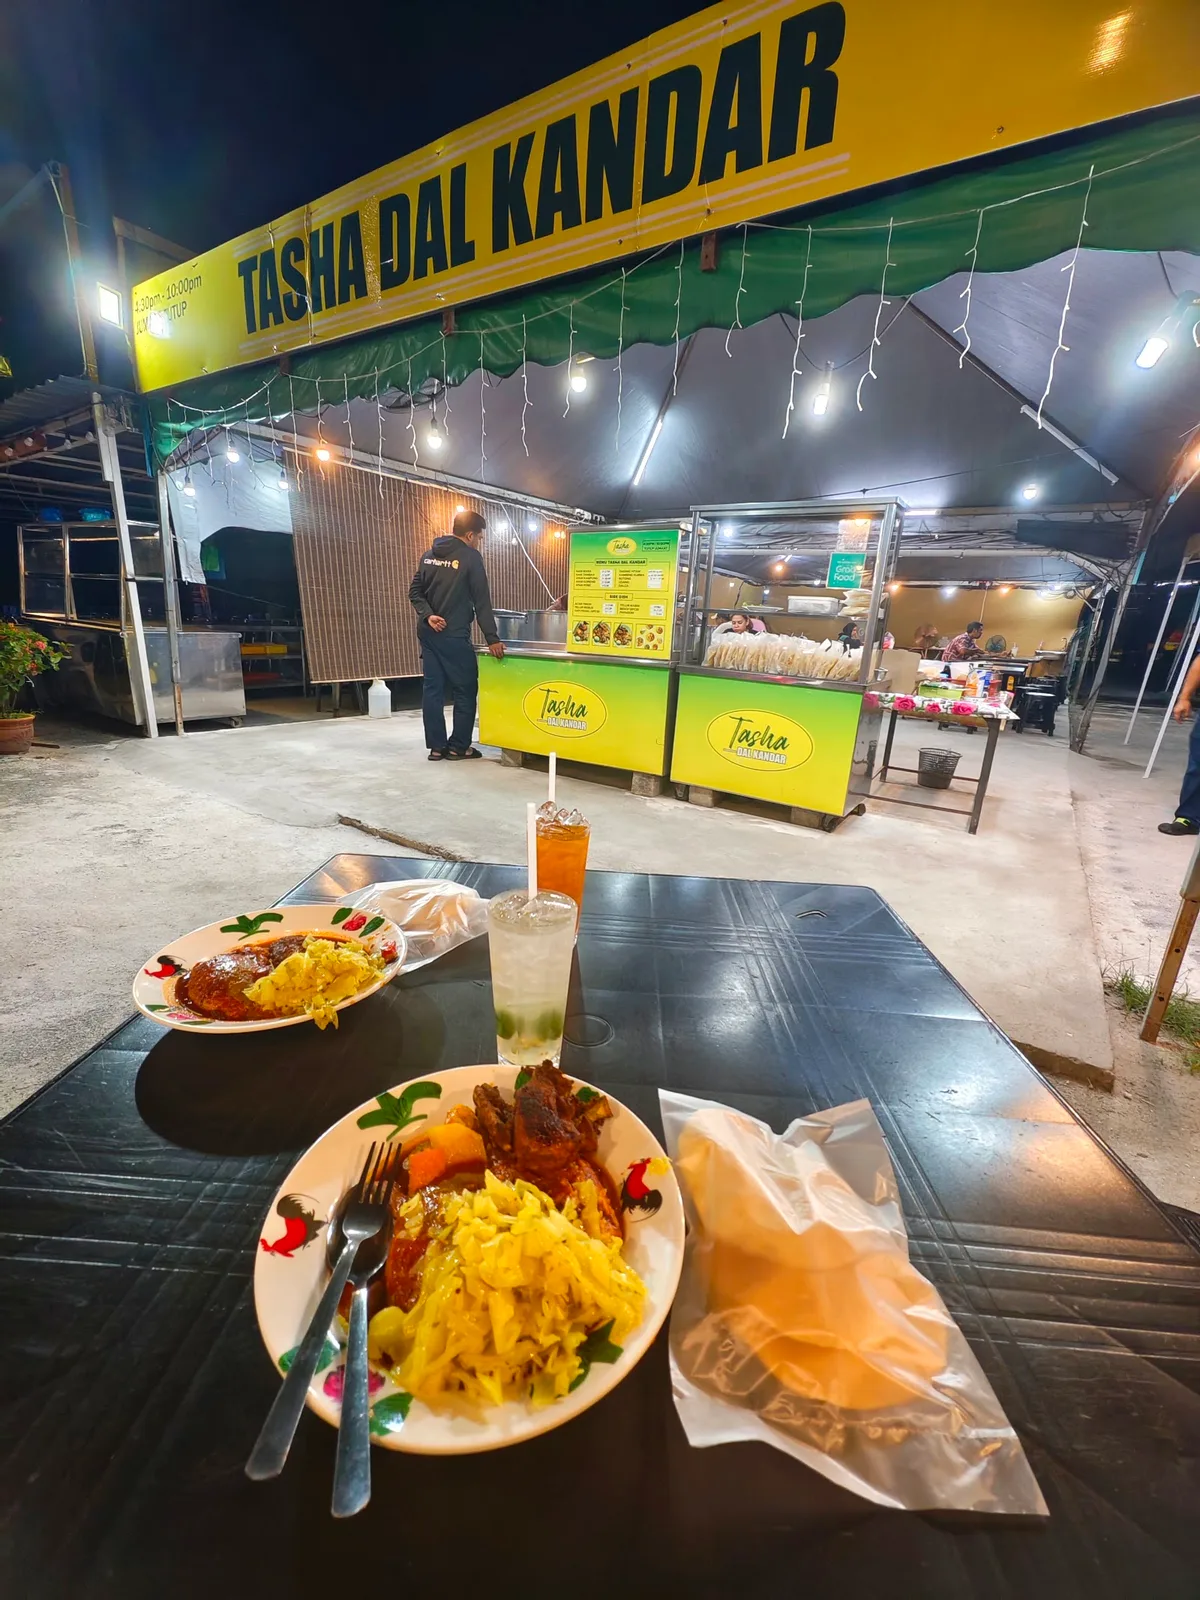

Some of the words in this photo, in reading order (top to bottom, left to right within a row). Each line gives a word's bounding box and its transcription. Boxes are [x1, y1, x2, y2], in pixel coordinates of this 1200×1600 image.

[238, 210, 367, 334] TASHA
[379, 162, 475, 292] DAL
[491, 1, 846, 253] KANDAR
[166, 275, 202, 300] 10:00pm
[424, 558, 452, 568] carhartt
[833, 573, 856, 581] Food
[539, 688, 588, 718] Tasha
[547, 716, 560, 727] DAL
[560, 718, 587, 730] KANDAR
[729, 716, 790, 751] Tasha
[737, 747, 752, 758] DAL
[752, 749, 787, 765] KANDAR
